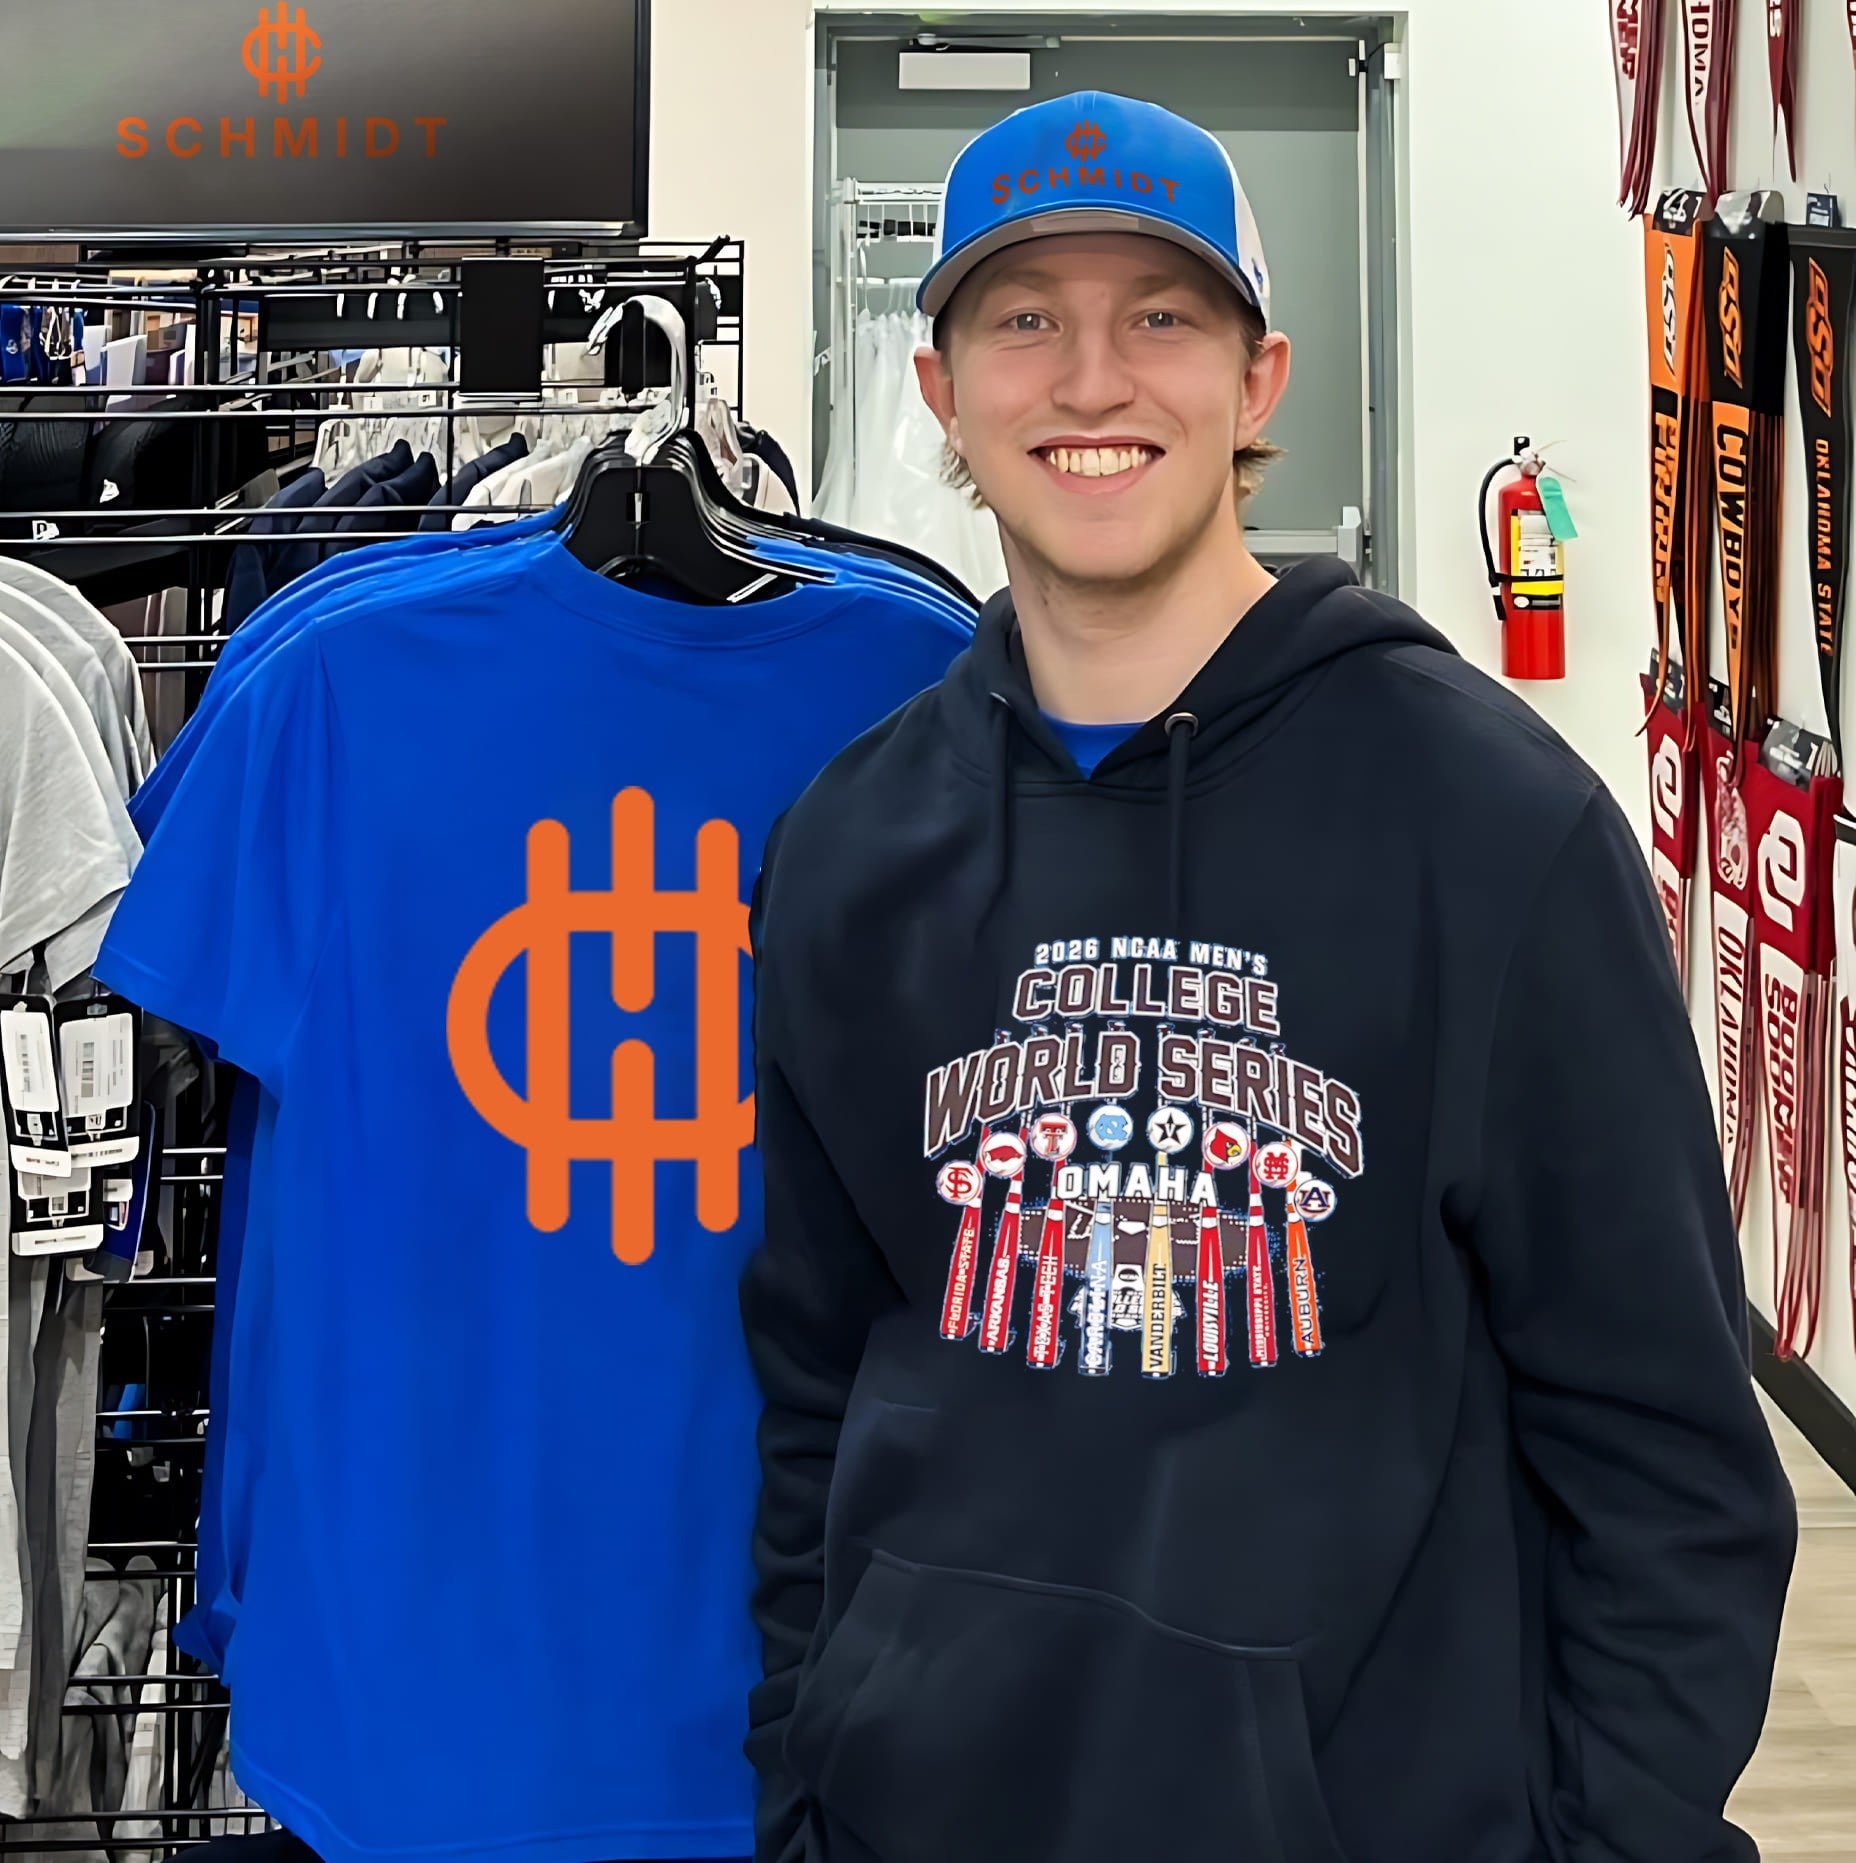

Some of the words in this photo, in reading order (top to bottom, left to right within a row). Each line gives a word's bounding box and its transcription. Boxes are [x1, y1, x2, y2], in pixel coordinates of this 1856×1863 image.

[115, 116, 447, 159] SCHMIDT
[991, 167, 1179, 204] SCHMIDT
[1816, 439, 1831, 570] OKLAHOMA
[1035, 938, 1098, 966] 2026
[1112, 937, 1177, 961] NCAA
[1190, 940, 1267, 976] MEN'S
[1012, 963, 1281, 1036] COLLEGE
[1719, 927, 1744, 1145] OKLAHOMA
[924, 1031, 1142, 1158] WORLD
[1158, 1034, 1364, 1177] SERIES
[1057, 1162, 1217, 1208] OMAHA
[948, 1274, 967, 1330] FLORIDA
[958, 1229, 975, 1270] STATE
[987, 1257, 1010, 1342] ARKANSAS
[1039, 1256, 1058, 1294] TECH
[1150, 1263, 1166, 1368] VANDERBILT
[1294, 1258, 1315, 1344] AUBURN
[1034, 1303, 1054, 1358] TEXAS
[1202, 1280, 1219, 1362] LOUISVILLE
